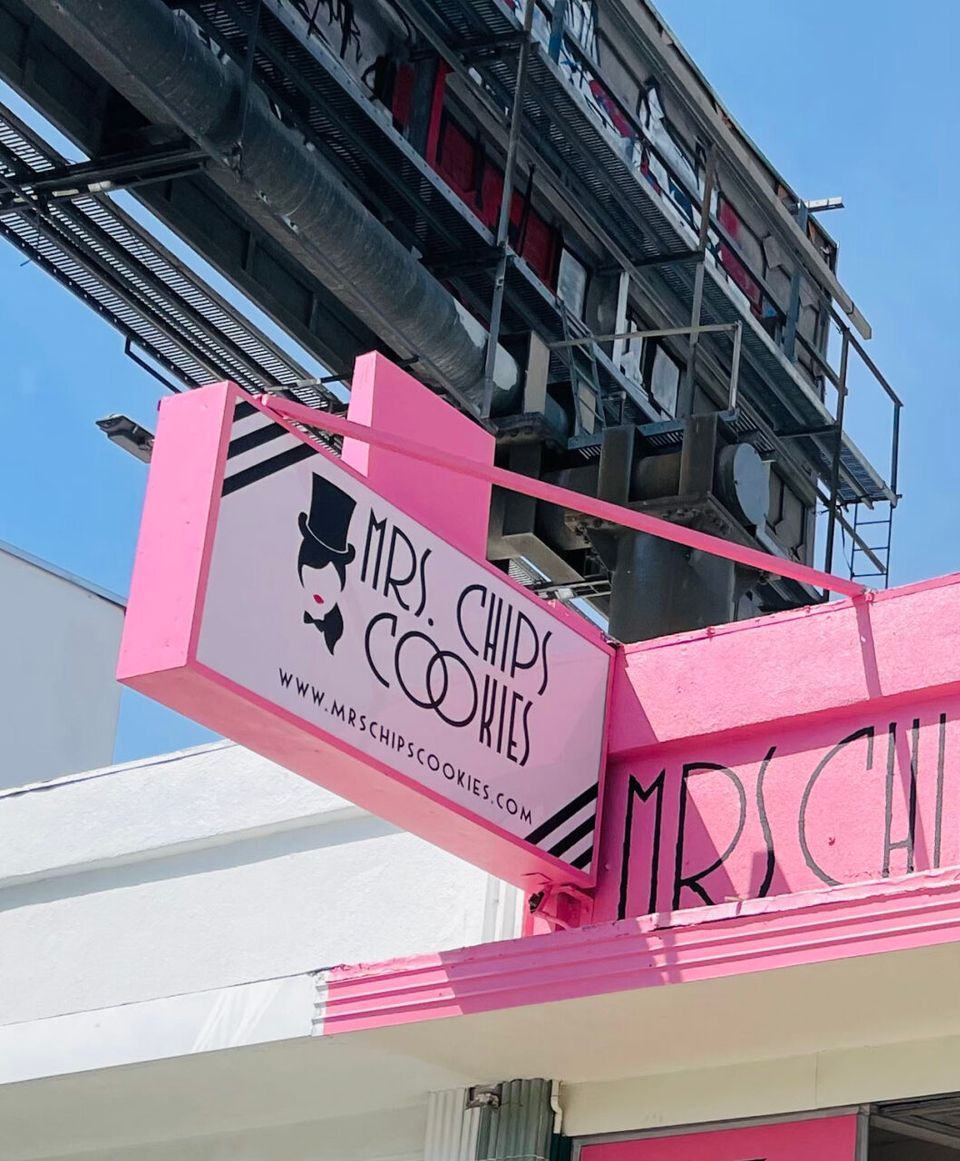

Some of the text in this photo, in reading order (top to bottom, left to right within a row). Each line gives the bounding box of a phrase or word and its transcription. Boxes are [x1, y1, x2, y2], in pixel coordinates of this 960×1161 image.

[361, 507, 552, 696] MRS. CHIPS
[279, 667, 533, 825] WWW.MRSCHIPSCOOKIES.COM
[365, 612, 533, 767] COOKIES
[618, 746, 777, 920] MRS
